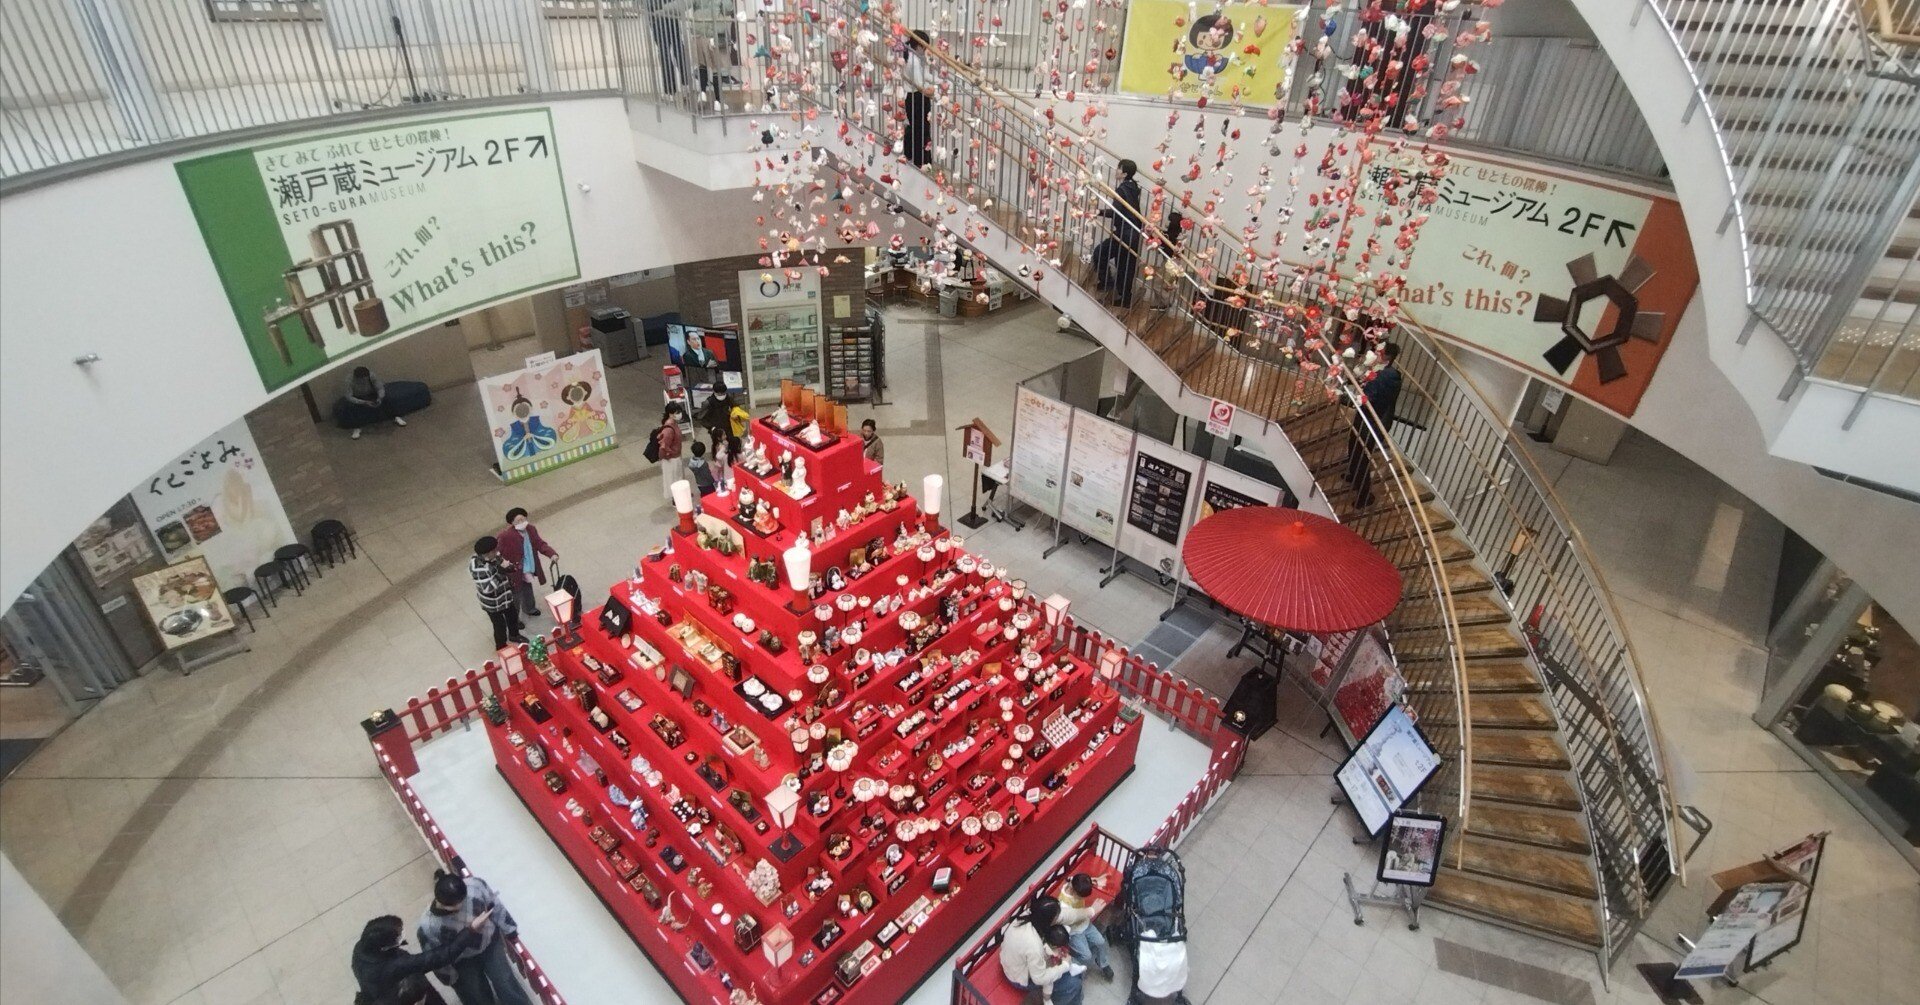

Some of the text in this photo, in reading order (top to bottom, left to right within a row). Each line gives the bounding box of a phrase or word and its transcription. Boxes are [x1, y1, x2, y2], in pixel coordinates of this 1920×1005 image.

[389, 221, 537, 314] What's this?
[1464, 288, 1533, 316] this?
